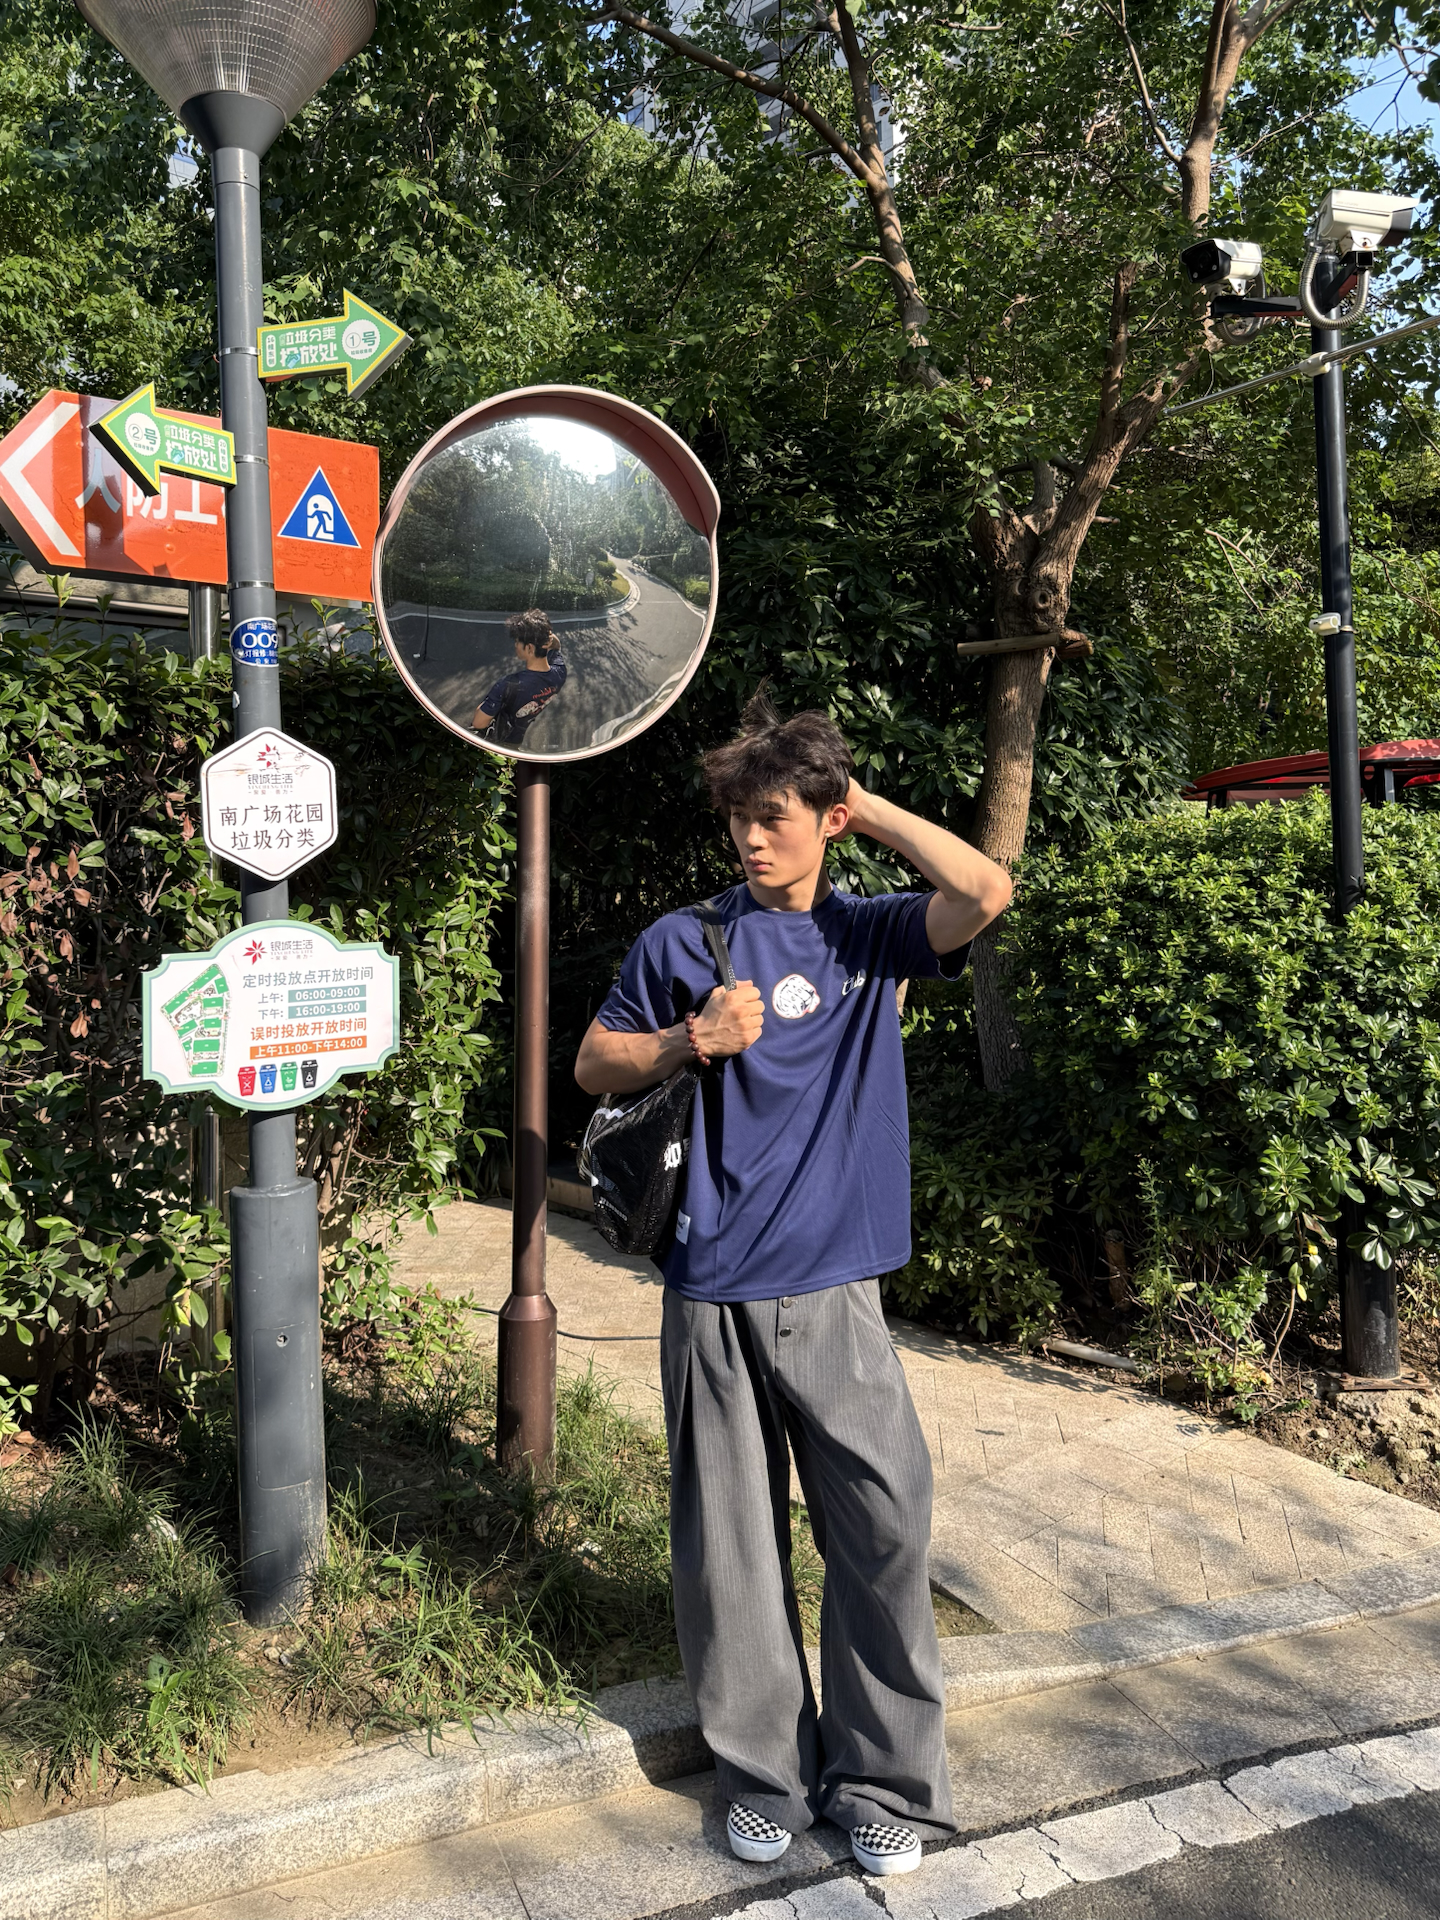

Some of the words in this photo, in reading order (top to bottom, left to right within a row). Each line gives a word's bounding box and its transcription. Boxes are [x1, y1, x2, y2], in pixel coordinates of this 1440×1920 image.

[280, 326, 336, 346] 垃圾分类
[164, 425, 216, 450] 垃圾分类
[247, 773, 294, 785] 银城生活
[219, 803, 323, 827] 南广场花园
[231, 828, 315, 851] 垃圾分类
[270, 939, 314, 952] 银城生活
[242, 966, 374, 989] 定时投放点开放时间
[295, 987, 360, 1001] 06:00-09:00
[295, 1002, 360, 1017] 16:00-19:00
[250, 1017, 367, 1041] 误时投放开放时间
[254, 1037, 363, 1058] 上午11:00-下午14:00
